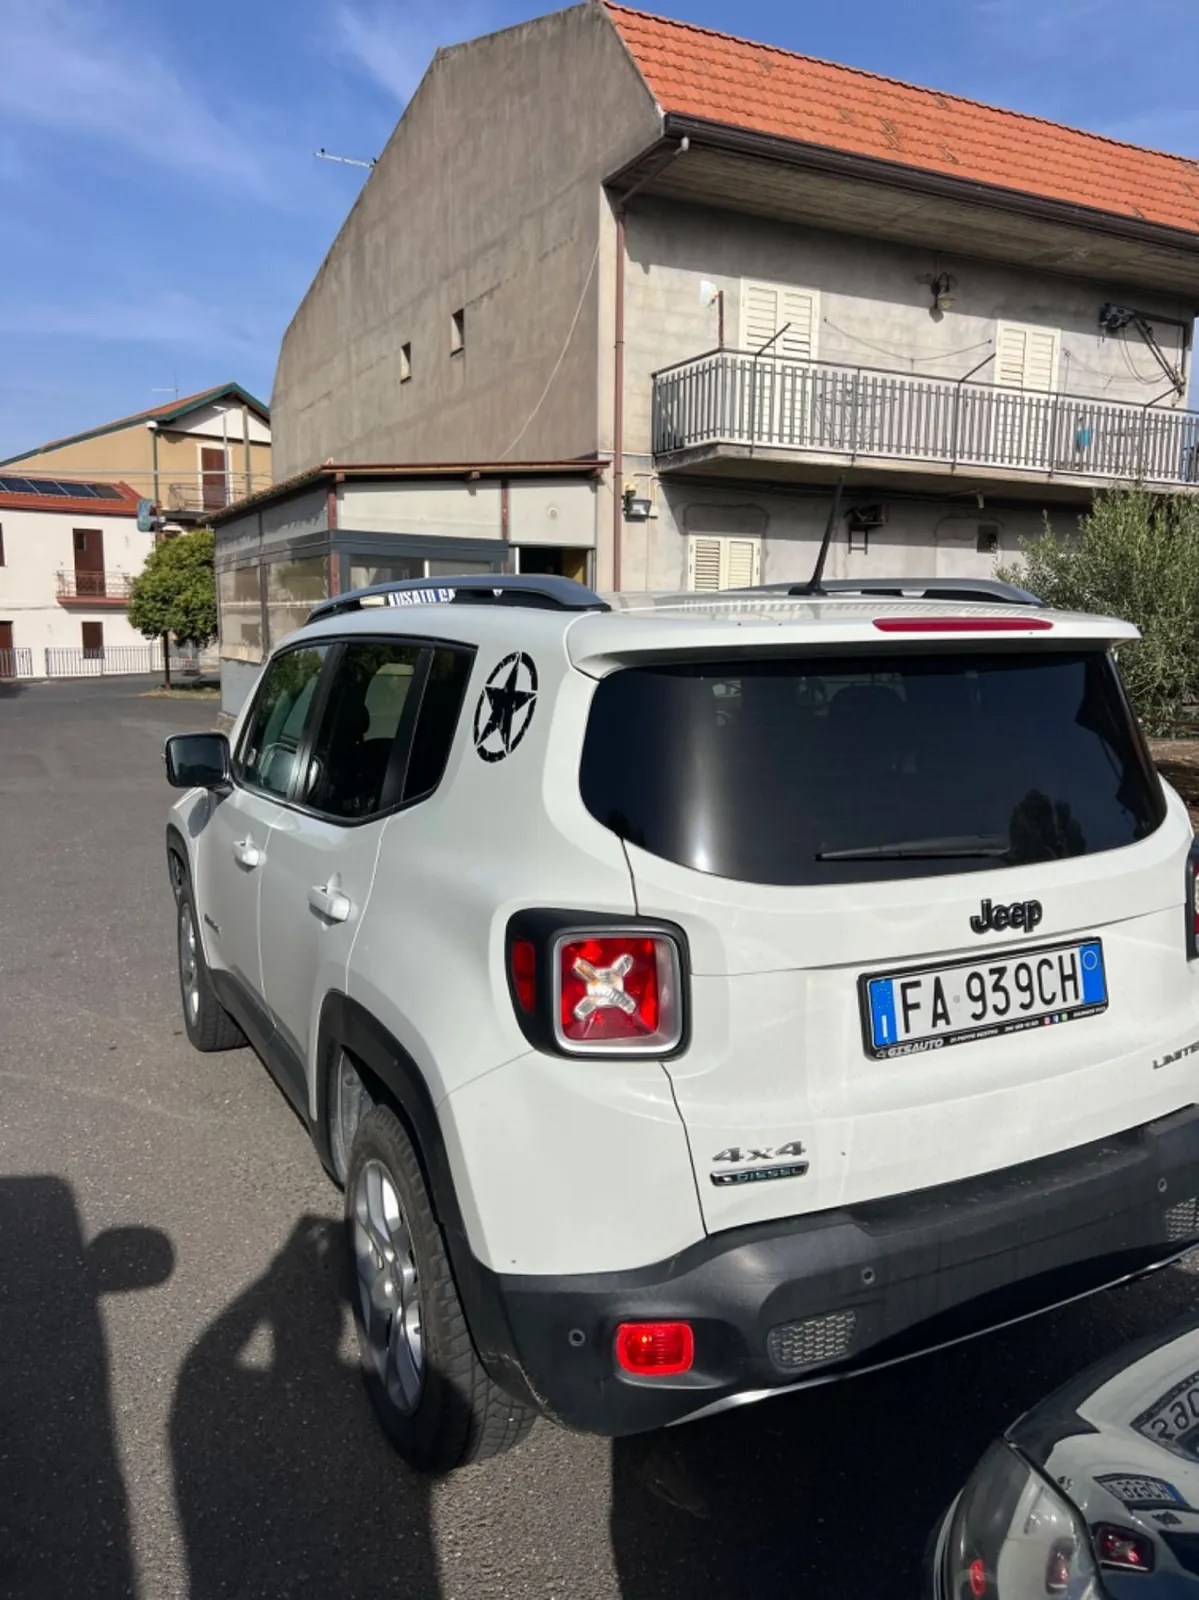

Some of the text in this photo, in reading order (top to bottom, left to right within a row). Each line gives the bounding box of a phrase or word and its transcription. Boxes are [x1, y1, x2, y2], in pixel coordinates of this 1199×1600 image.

[970, 899, 1043, 934] Jeep
[901, 953, 1080, 1033] FA 939CH
